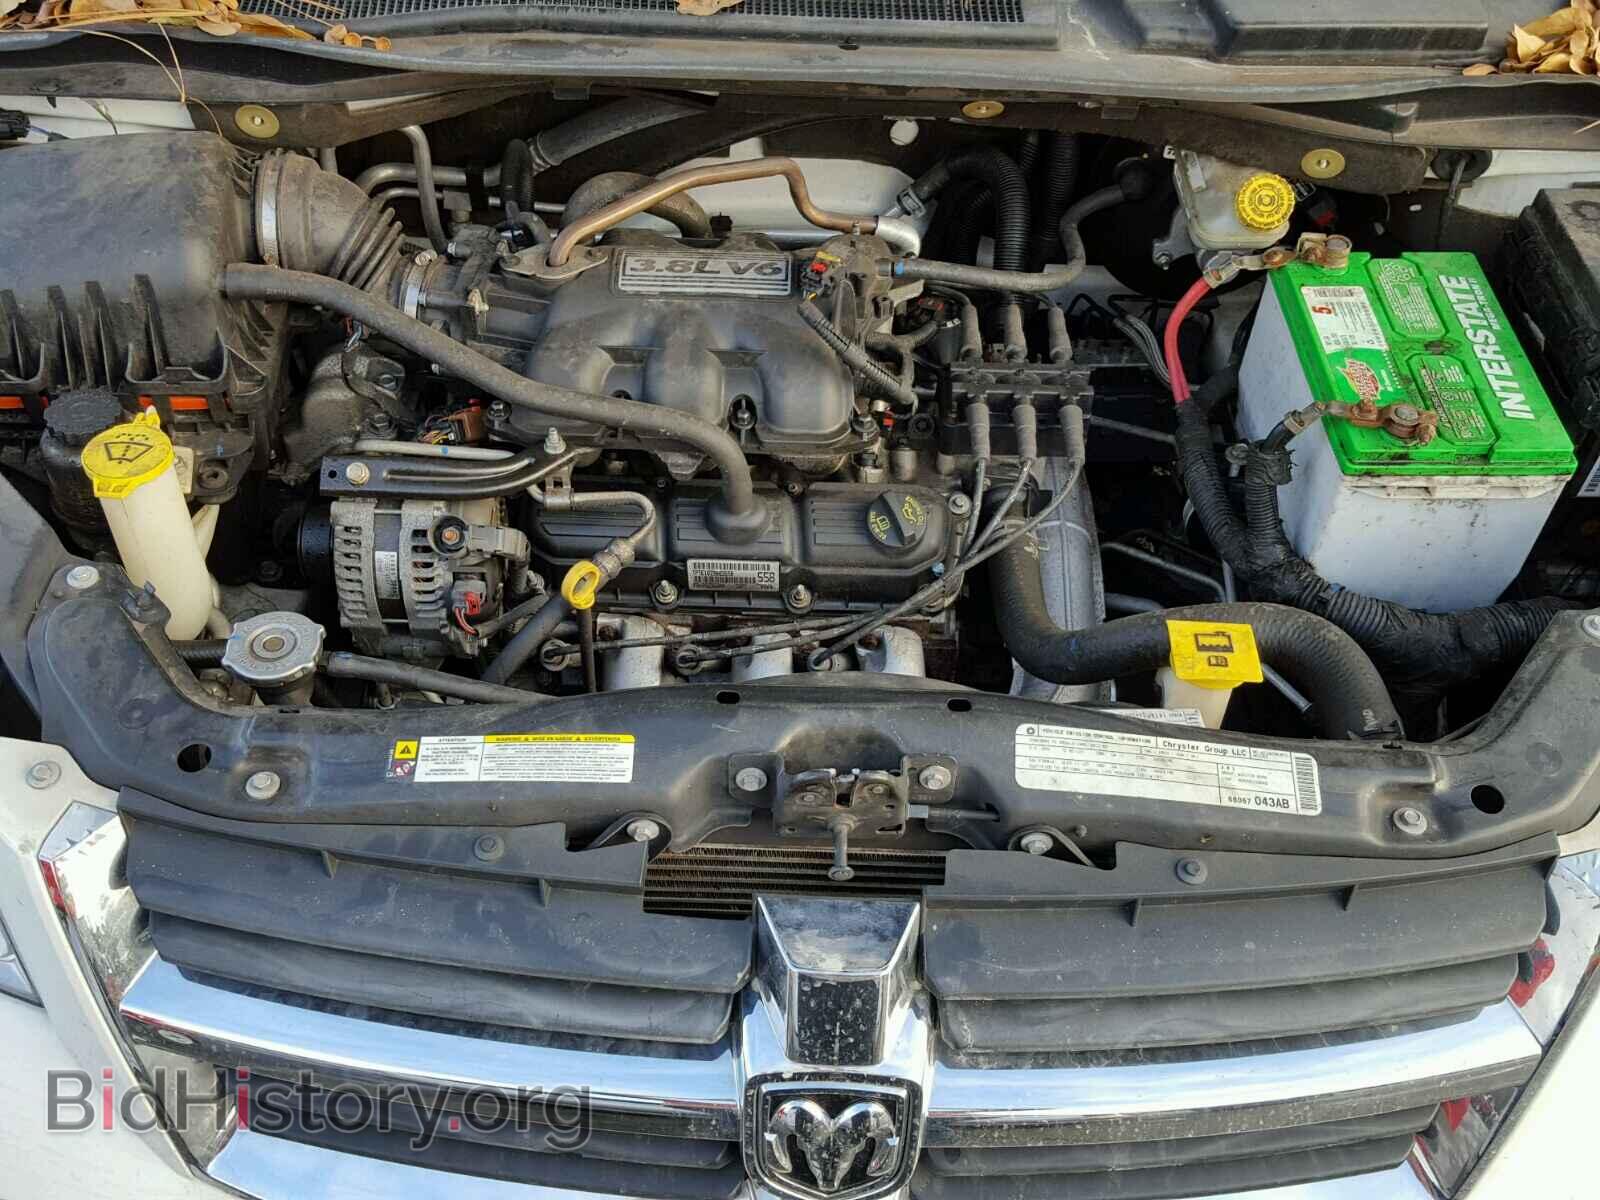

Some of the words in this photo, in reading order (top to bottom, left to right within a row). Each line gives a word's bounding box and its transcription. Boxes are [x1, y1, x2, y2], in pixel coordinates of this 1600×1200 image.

[629, 257, 720, 275] 3.8L
[726, 260, 783, 276] V6
[1438, 274, 1536, 420] INTERSTATE
[757, 571, 775, 583] 558
[1162, 740, 1199, 751] Chrysler
[1204, 746, 1228, 757] Group
[1231, 748, 1247, 756] LLC
[1254, 796, 1290, 809] 043AB
